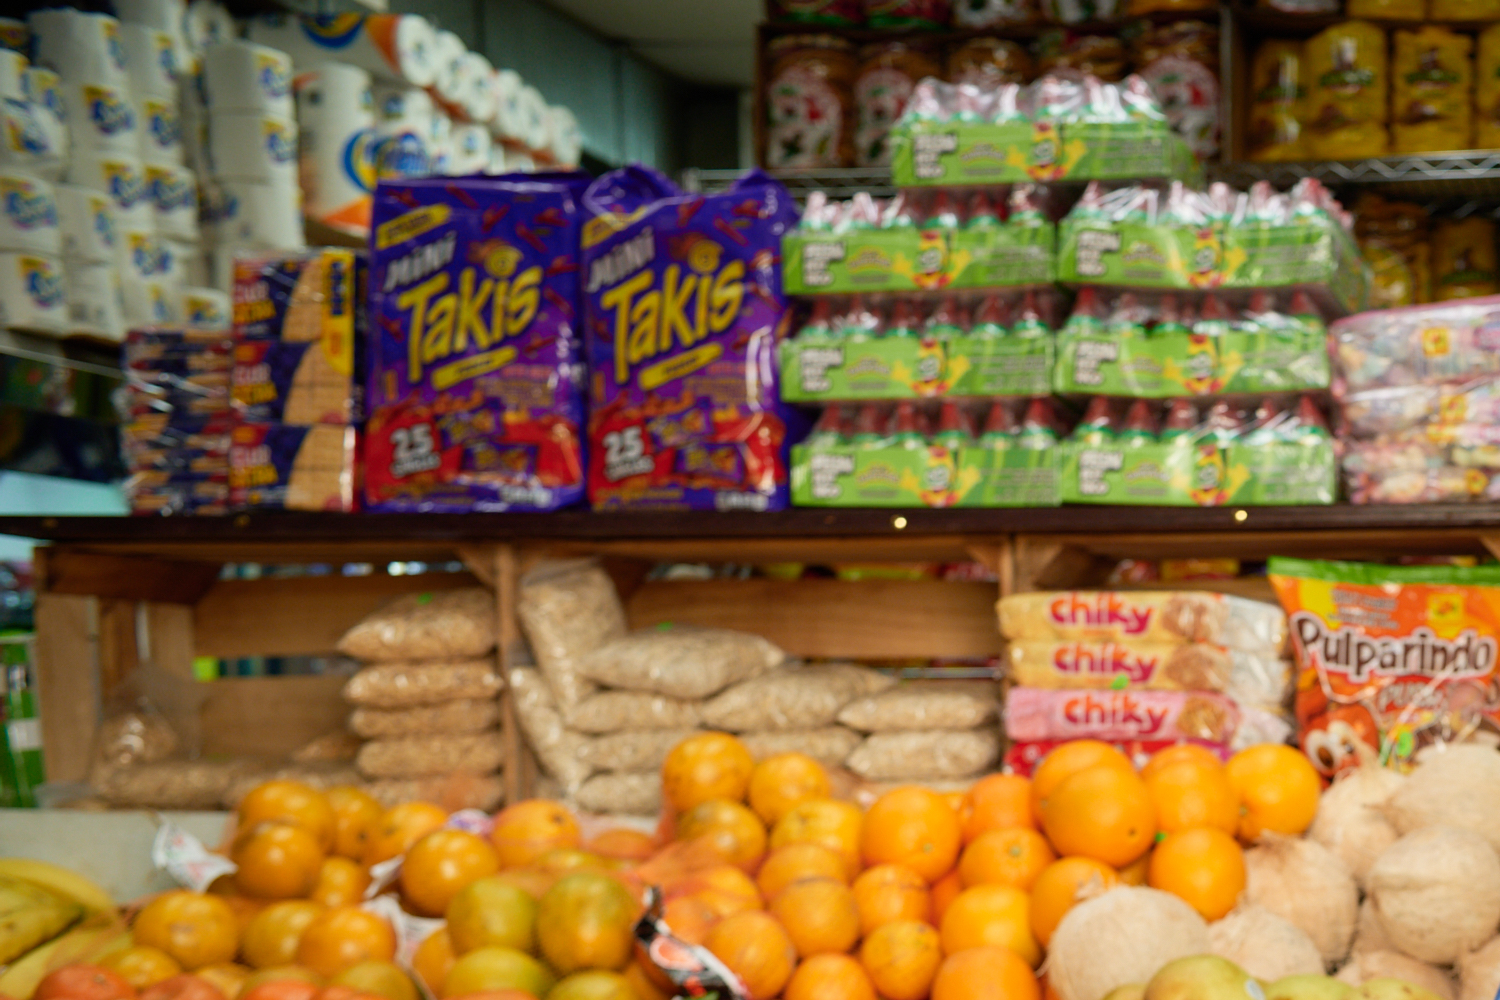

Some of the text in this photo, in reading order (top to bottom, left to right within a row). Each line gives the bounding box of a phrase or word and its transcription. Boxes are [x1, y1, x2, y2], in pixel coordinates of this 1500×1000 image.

[396, 265, 543, 383] Takis
[601, 259, 745, 384] Takis
[390, 423, 434, 457] 25
[602, 426, 644, 459] 25
[1293, 616, 1494, 678] Pulparindo
